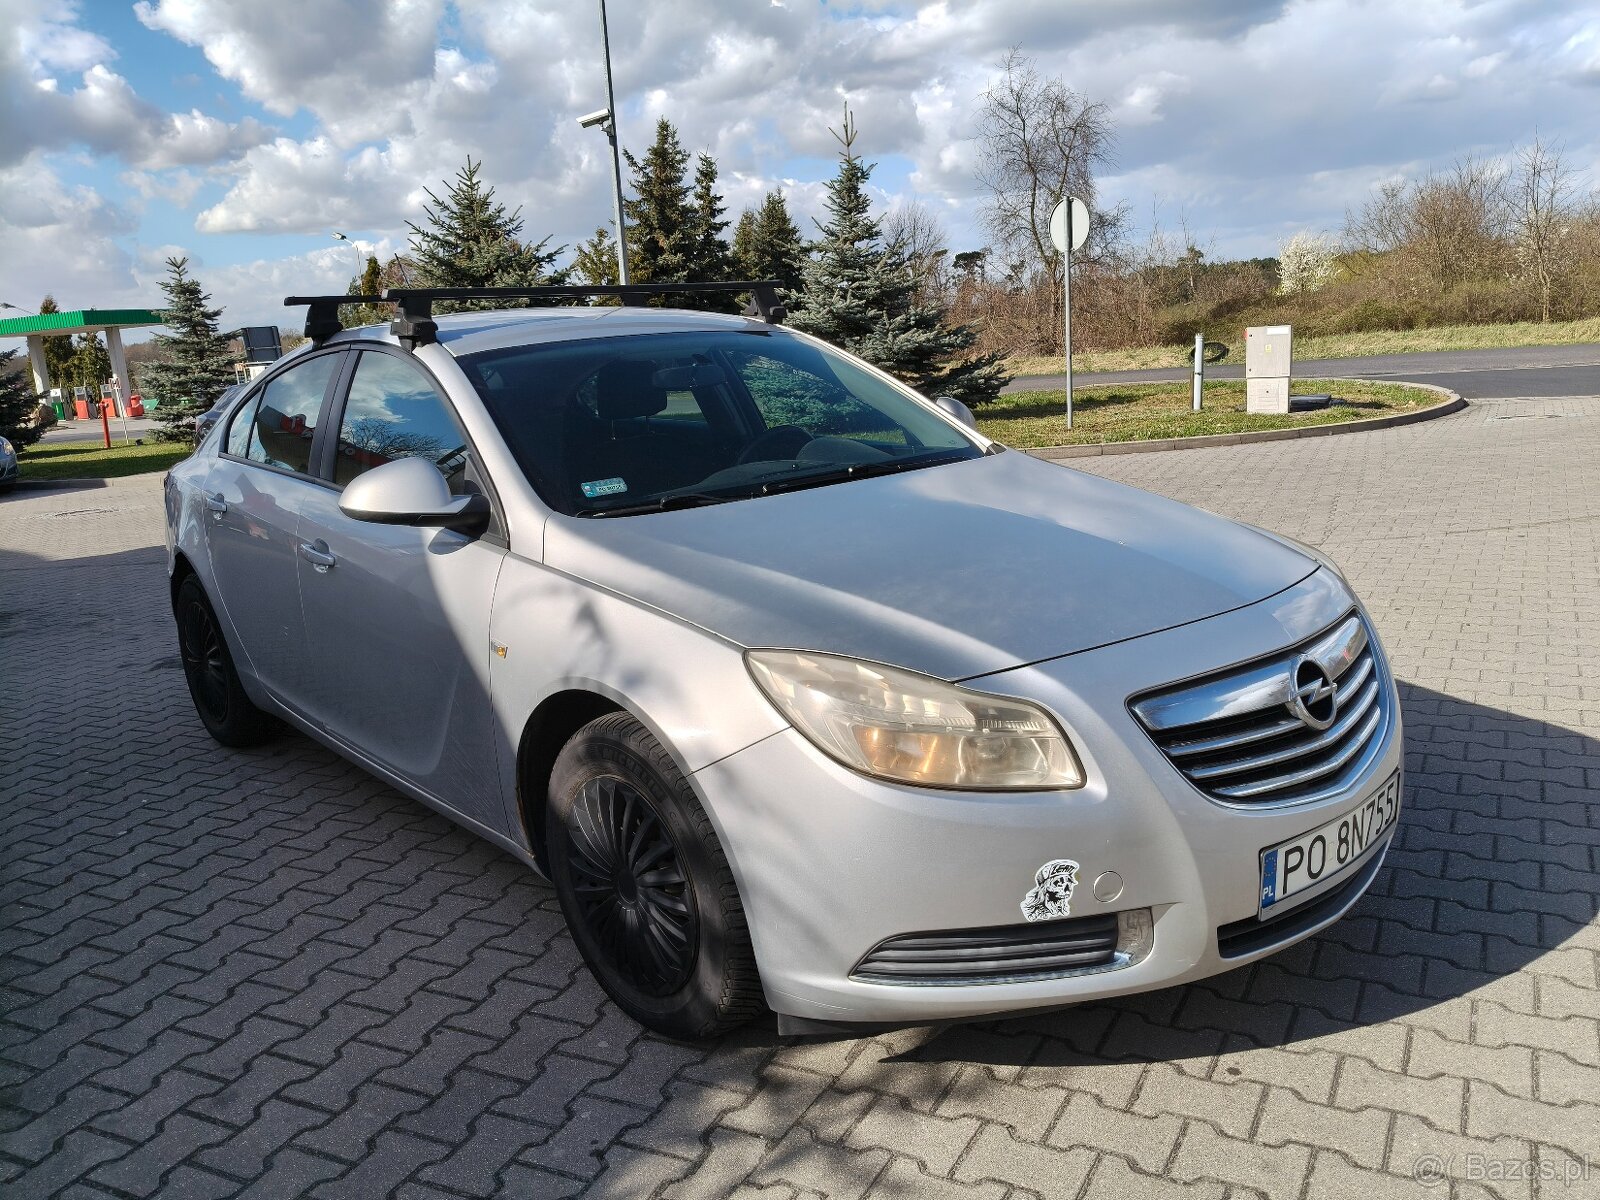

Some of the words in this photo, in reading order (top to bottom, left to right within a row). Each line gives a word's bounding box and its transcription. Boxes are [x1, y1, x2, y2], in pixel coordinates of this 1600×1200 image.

[1283, 834, 1326, 895] PO
[1336, 781, 1395, 864] 8N755
[1262, 885, 1274, 900] PL
